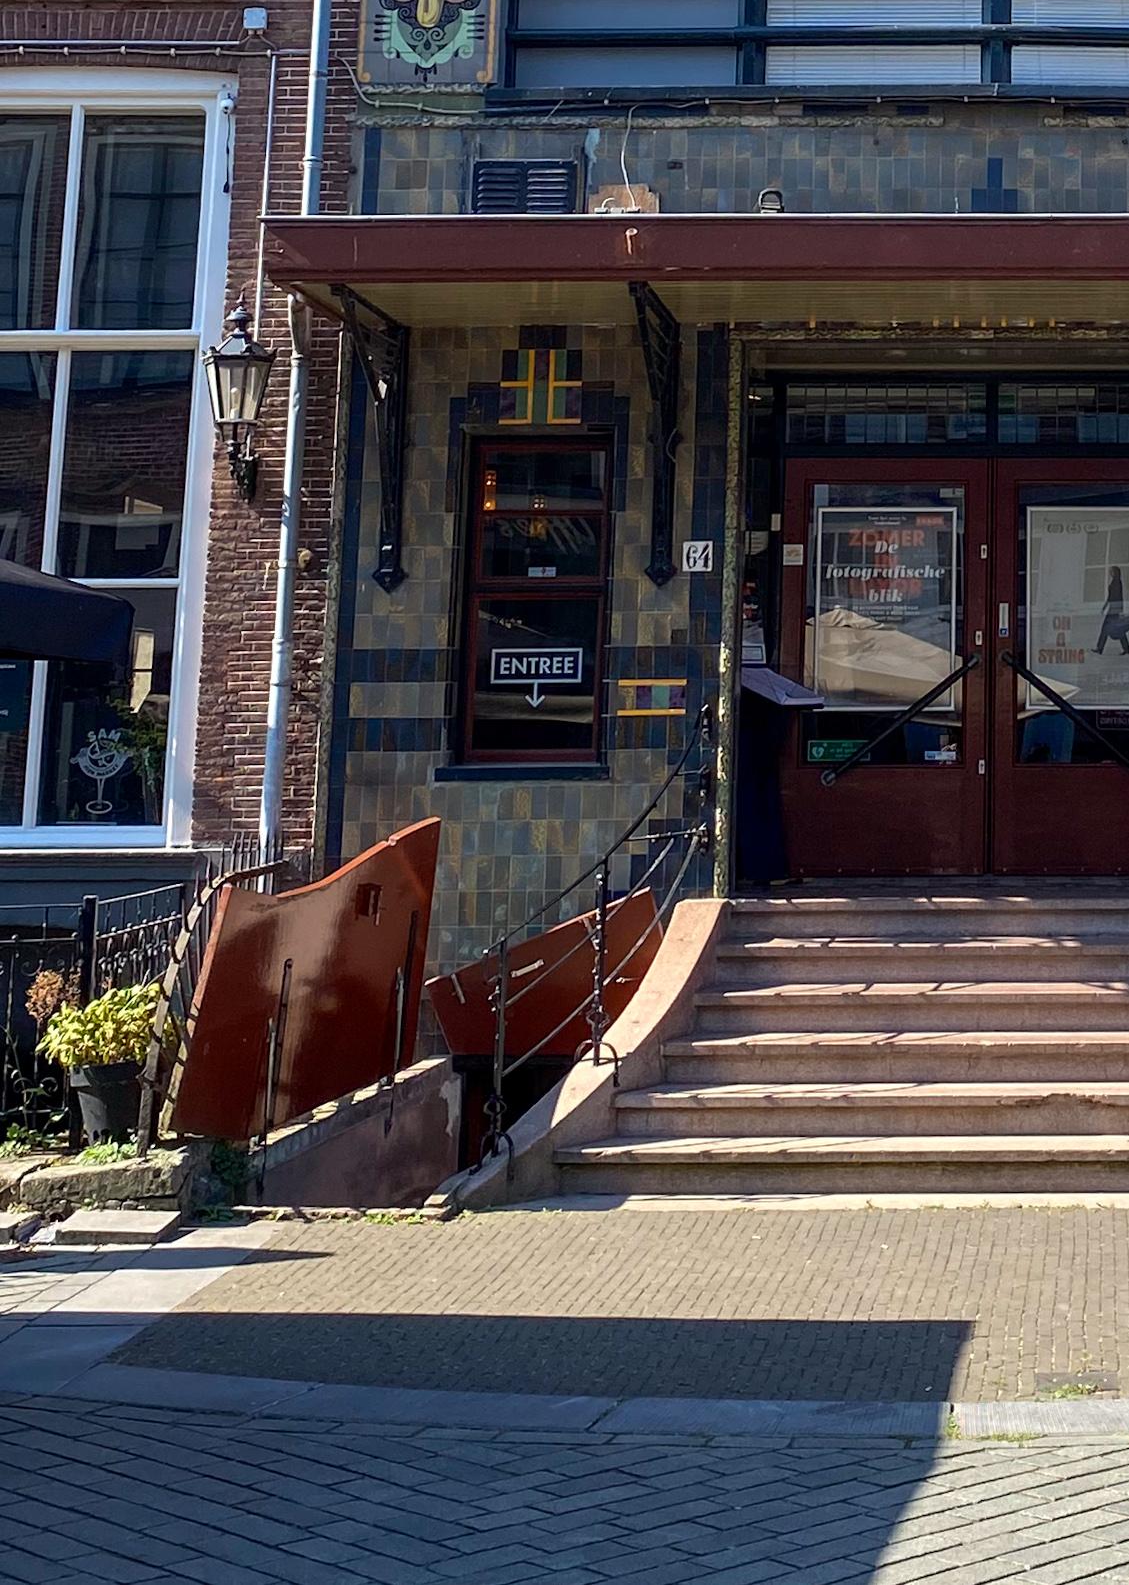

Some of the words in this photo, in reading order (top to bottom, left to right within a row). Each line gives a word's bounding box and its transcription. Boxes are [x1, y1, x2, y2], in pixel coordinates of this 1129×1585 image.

[874, 540, 899, 554] De
[686, 543, 711, 569] 64
[825, 564, 946, 582] fotografische
[868, 588, 904, 603] blik
[1038, 648, 1085, 664] STRING
[500, 657, 574, 674] ENTREE
[87, 728, 121, 743] SAM
